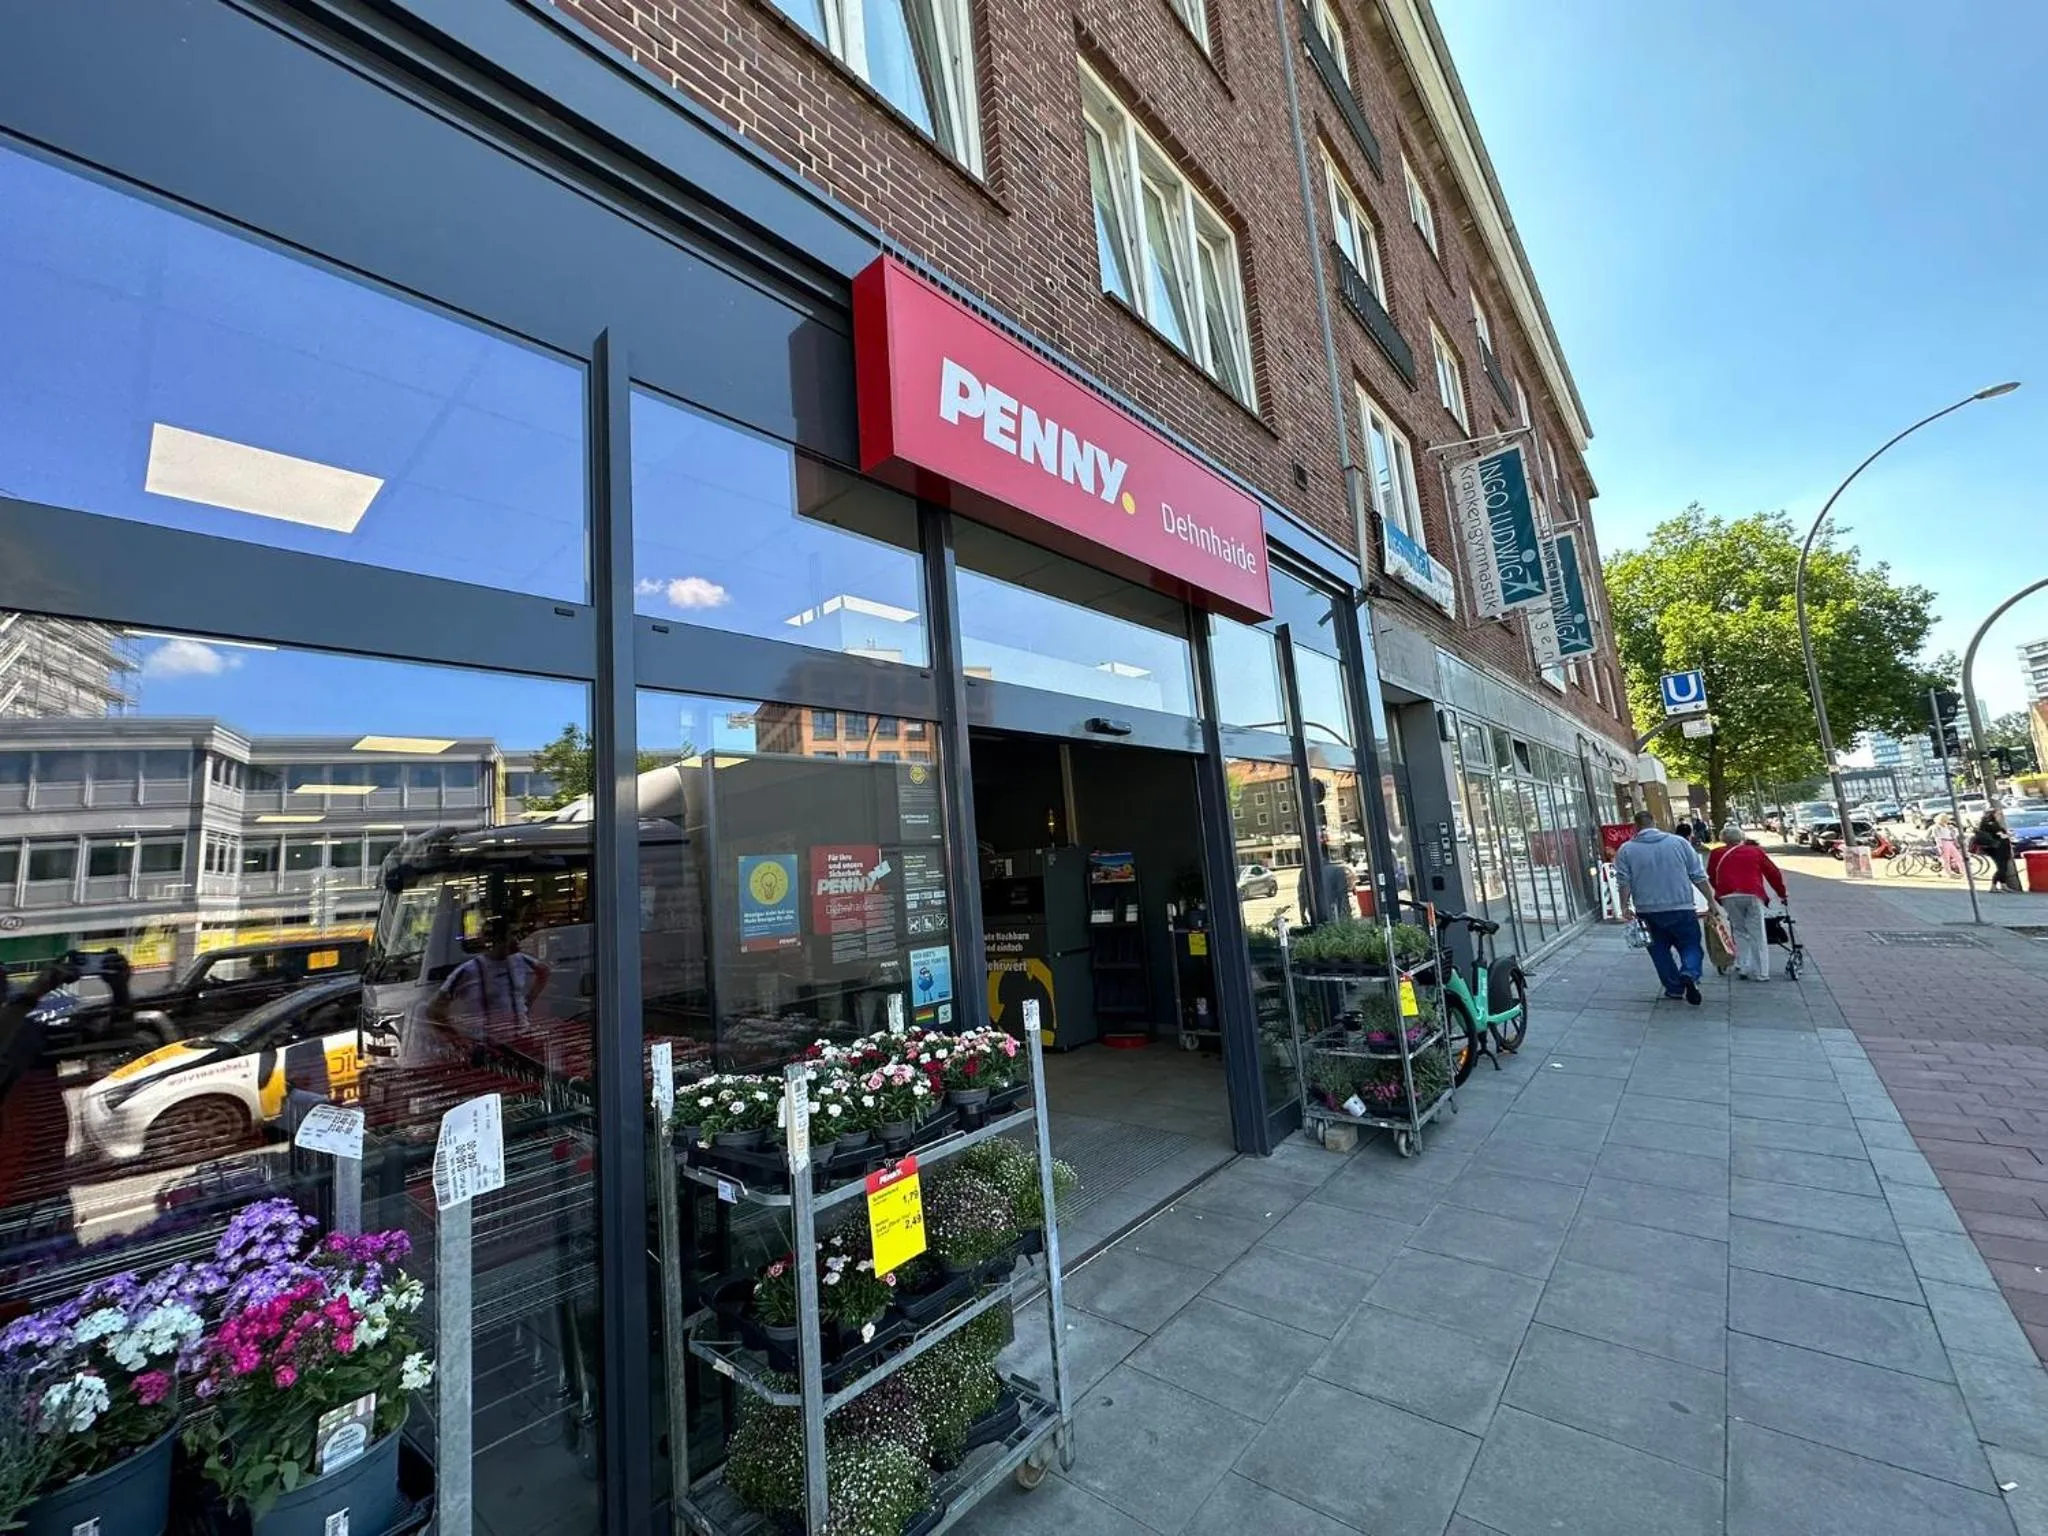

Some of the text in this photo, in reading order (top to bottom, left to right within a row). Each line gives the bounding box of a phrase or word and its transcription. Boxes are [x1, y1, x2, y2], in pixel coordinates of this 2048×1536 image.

[1161, 502, 1257, 574] Dehnhaide
[1460, 464, 1497, 611] Krankengymnastik
[1479, 459, 1523, 585] INGO LUDWIG
[1667, 674, 1698, 702] U
[985, 959, 1028, 972] ehrwert
